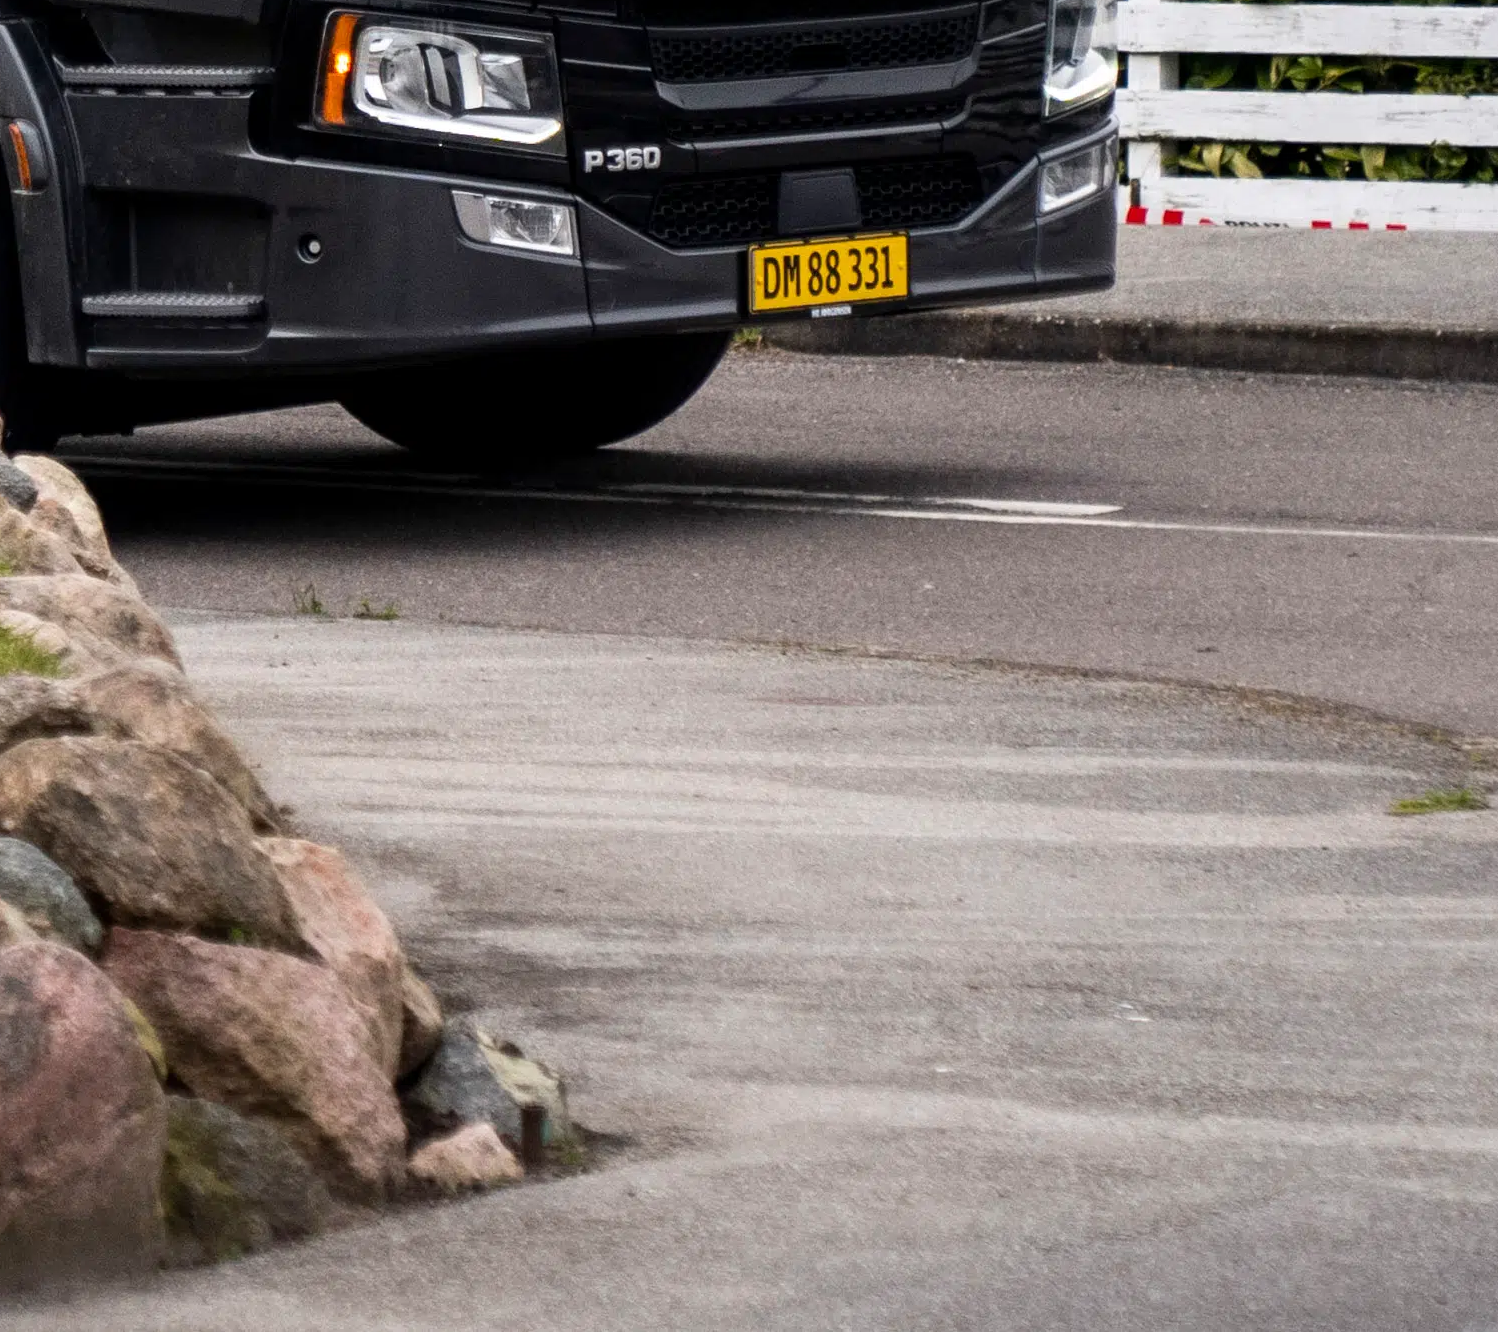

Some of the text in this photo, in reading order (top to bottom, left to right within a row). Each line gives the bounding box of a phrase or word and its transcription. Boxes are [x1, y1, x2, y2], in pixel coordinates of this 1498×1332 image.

[763, 245, 894, 299] DM 88 331
